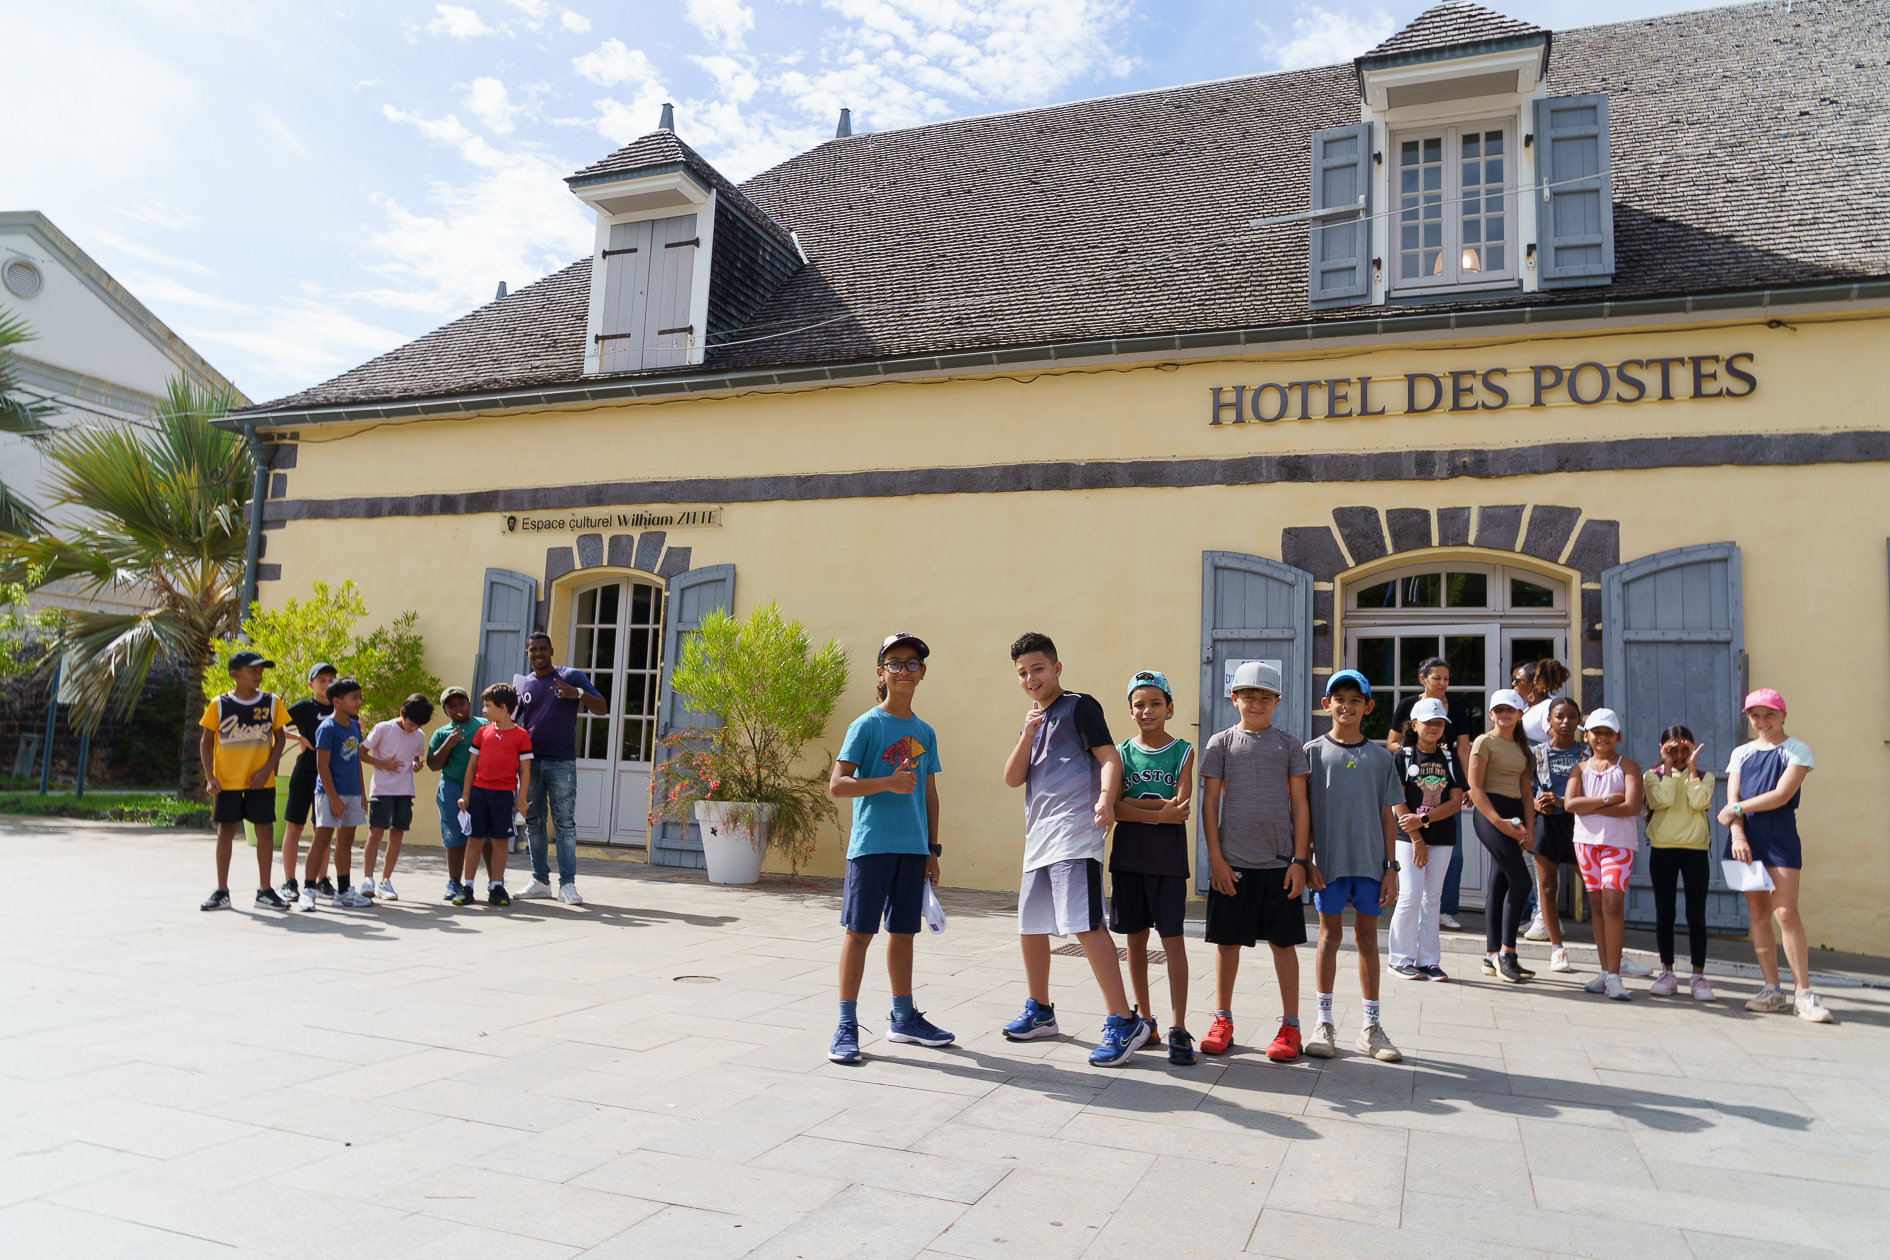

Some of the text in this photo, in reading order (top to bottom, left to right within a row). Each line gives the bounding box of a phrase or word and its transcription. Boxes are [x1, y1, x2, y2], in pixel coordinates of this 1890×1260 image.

[1209, 353, 1757, 426] HOTEL DES POSTES
[522, 517, 565, 532] Espace
[569, 515, 612, 529] culturel
[677, 510, 717, 525] ZITTE
[253, 706, 270, 720] 23
[1124, 769, 1178, 792] BOSTO
